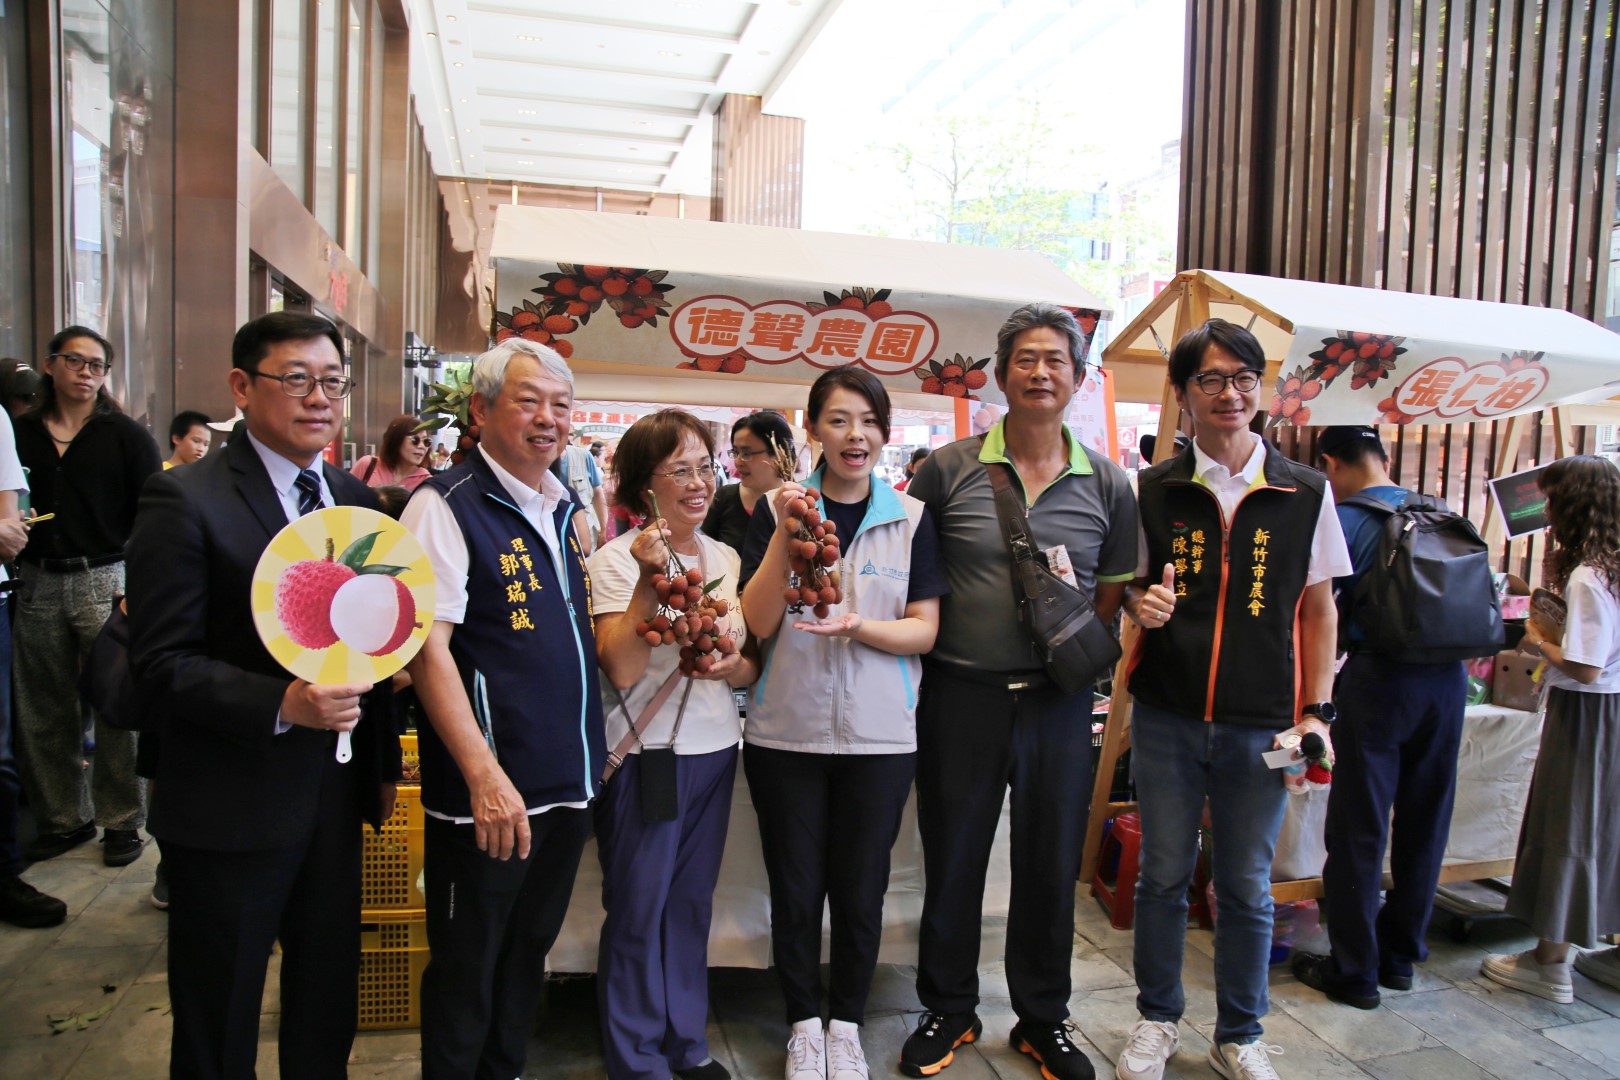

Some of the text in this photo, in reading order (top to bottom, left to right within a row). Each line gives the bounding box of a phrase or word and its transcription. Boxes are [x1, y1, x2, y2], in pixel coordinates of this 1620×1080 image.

[688, 306, 926, 363] 德聲農園
[1401, 369, 1537, 409] 張仁柏
[511, 537, 543, 592] 理事長
[1172, 536, 1189, 597] 陳學立
[1191, 529, 1206, 574] 總幹事
[1247, 528, 1271, 617] 新竹市農會
[498, 553, 535, 631] 郭瑞誠
